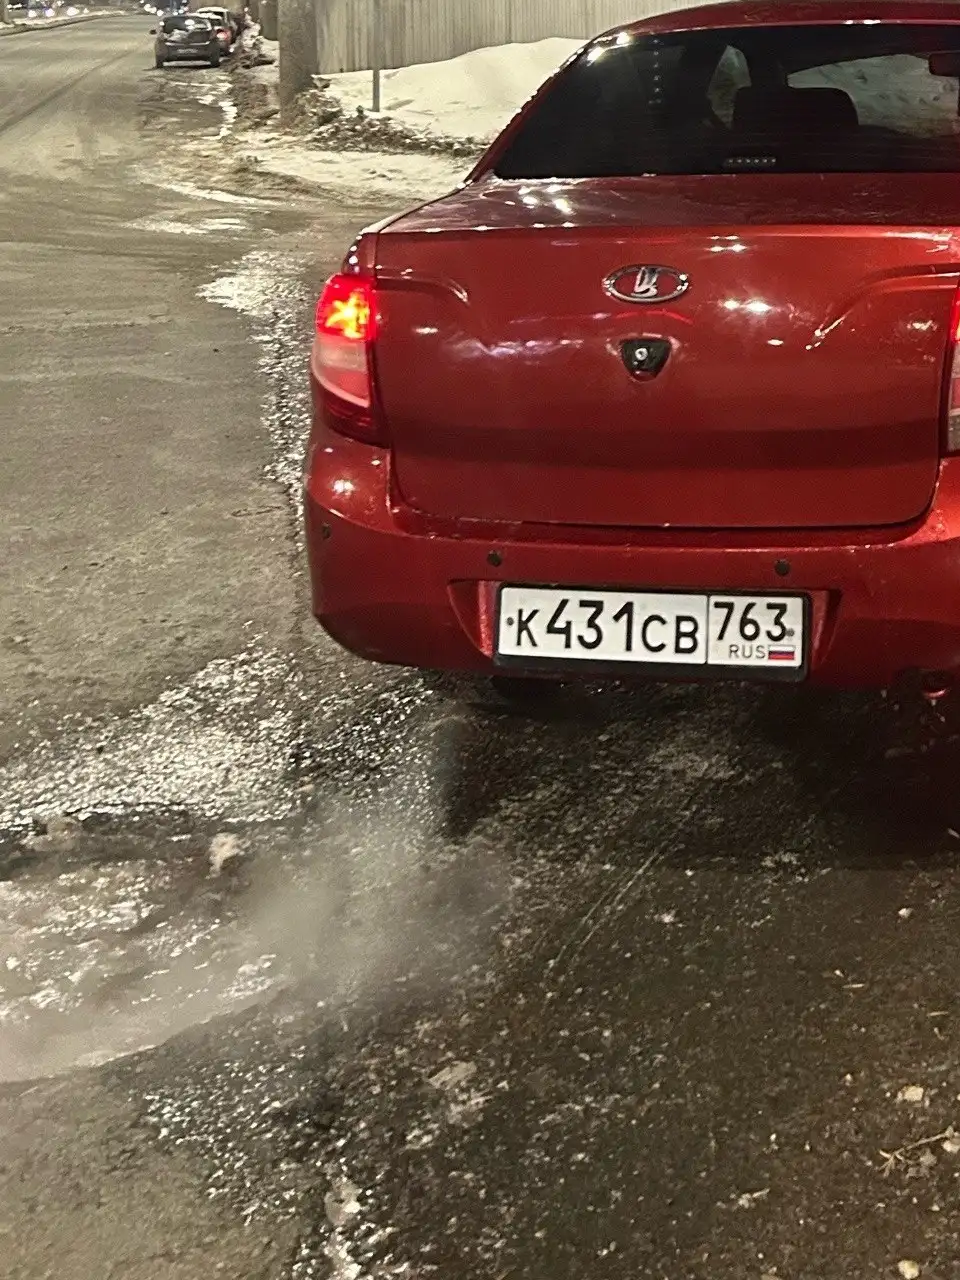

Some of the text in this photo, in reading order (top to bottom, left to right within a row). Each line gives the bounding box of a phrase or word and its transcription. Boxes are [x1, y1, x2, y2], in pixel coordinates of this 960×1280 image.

[516, 599, 788, 653] К431СВ 763
[728, 645, 765, 659] RUS
